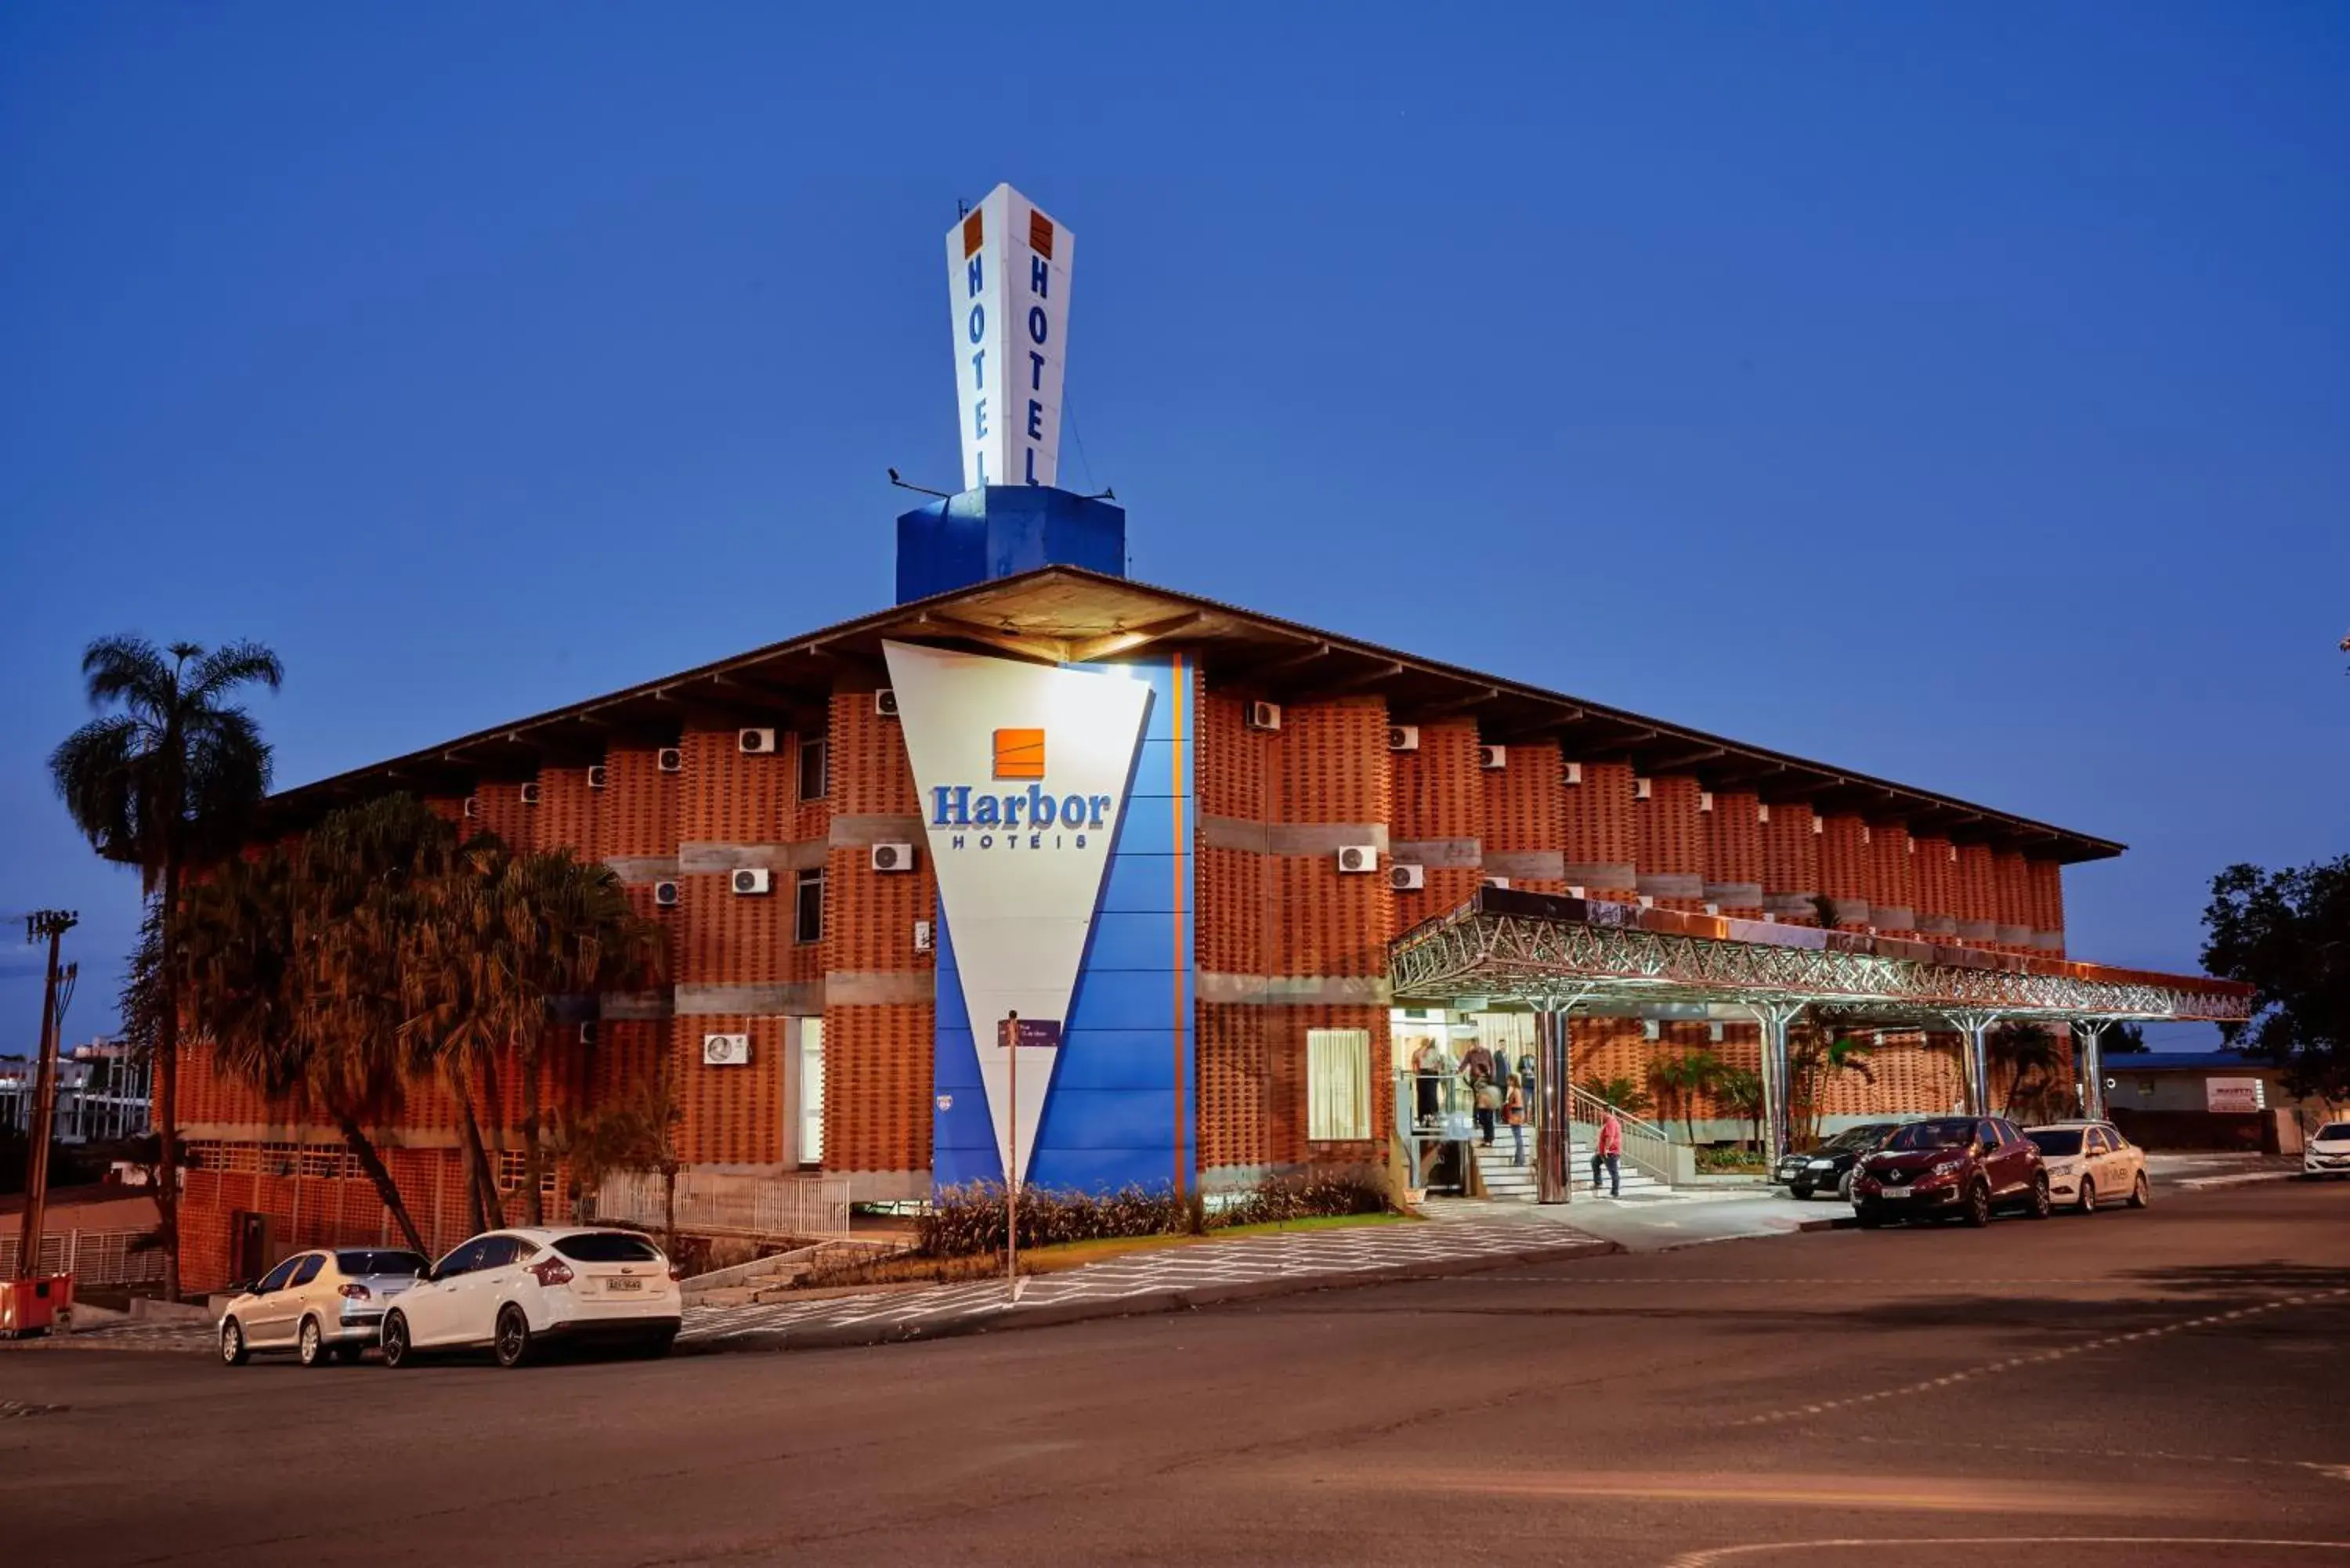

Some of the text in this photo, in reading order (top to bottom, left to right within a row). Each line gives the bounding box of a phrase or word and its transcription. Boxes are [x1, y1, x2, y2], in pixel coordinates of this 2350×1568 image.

[967, 255, 989, 487] HOTEL
[1025, 255, 1048, 487] HOTEL
[931, 783, 1112, 827] Harbor
